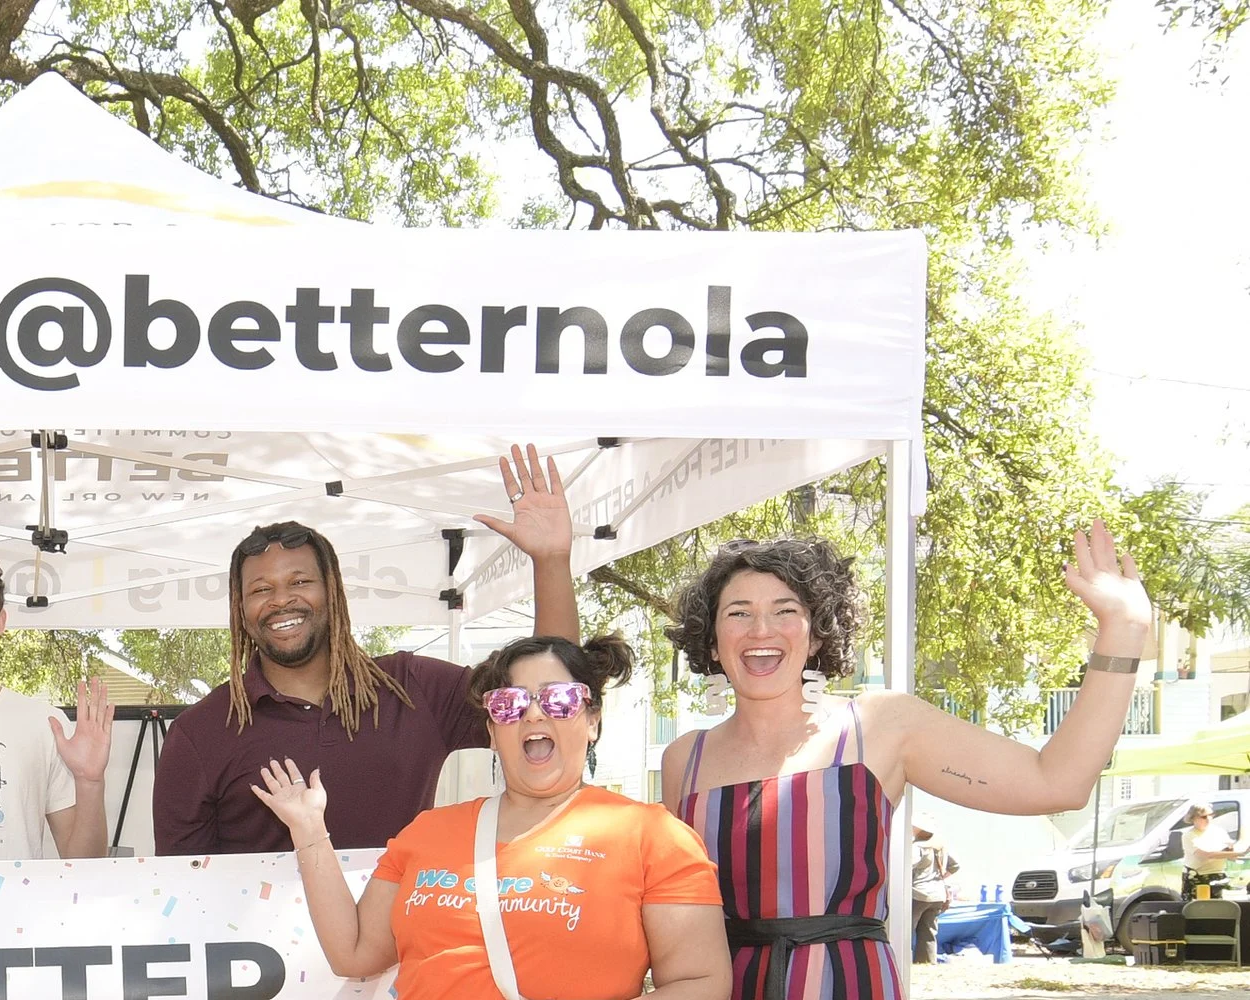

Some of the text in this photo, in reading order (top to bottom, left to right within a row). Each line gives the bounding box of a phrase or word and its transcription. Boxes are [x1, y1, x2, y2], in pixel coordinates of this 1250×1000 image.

[415, 869, 534, 895] We cre
[405, 890, 582, 932] for our mmunity
